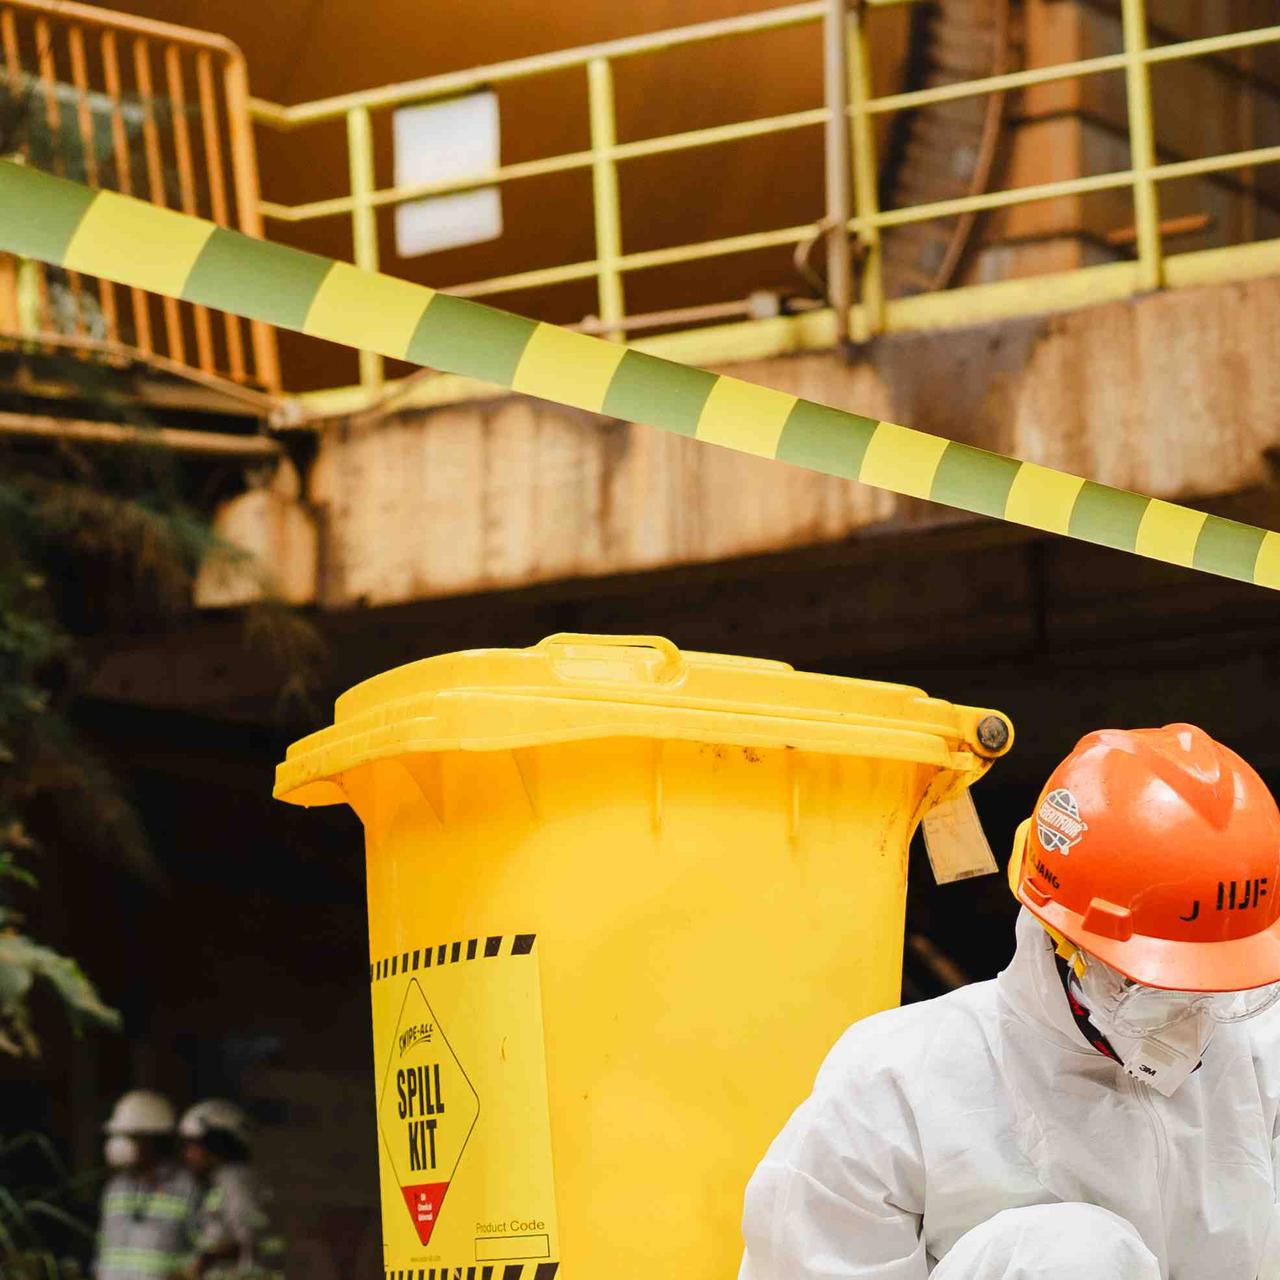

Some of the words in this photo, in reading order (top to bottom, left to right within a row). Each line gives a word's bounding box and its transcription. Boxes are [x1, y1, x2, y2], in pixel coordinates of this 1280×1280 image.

[396, 1063, 445, 1120] SPILL
[408, 1118, 438, 1172] KIT
[475, 1221, 507, 1234] Product
[510, 1219, 546, 1232] Code
